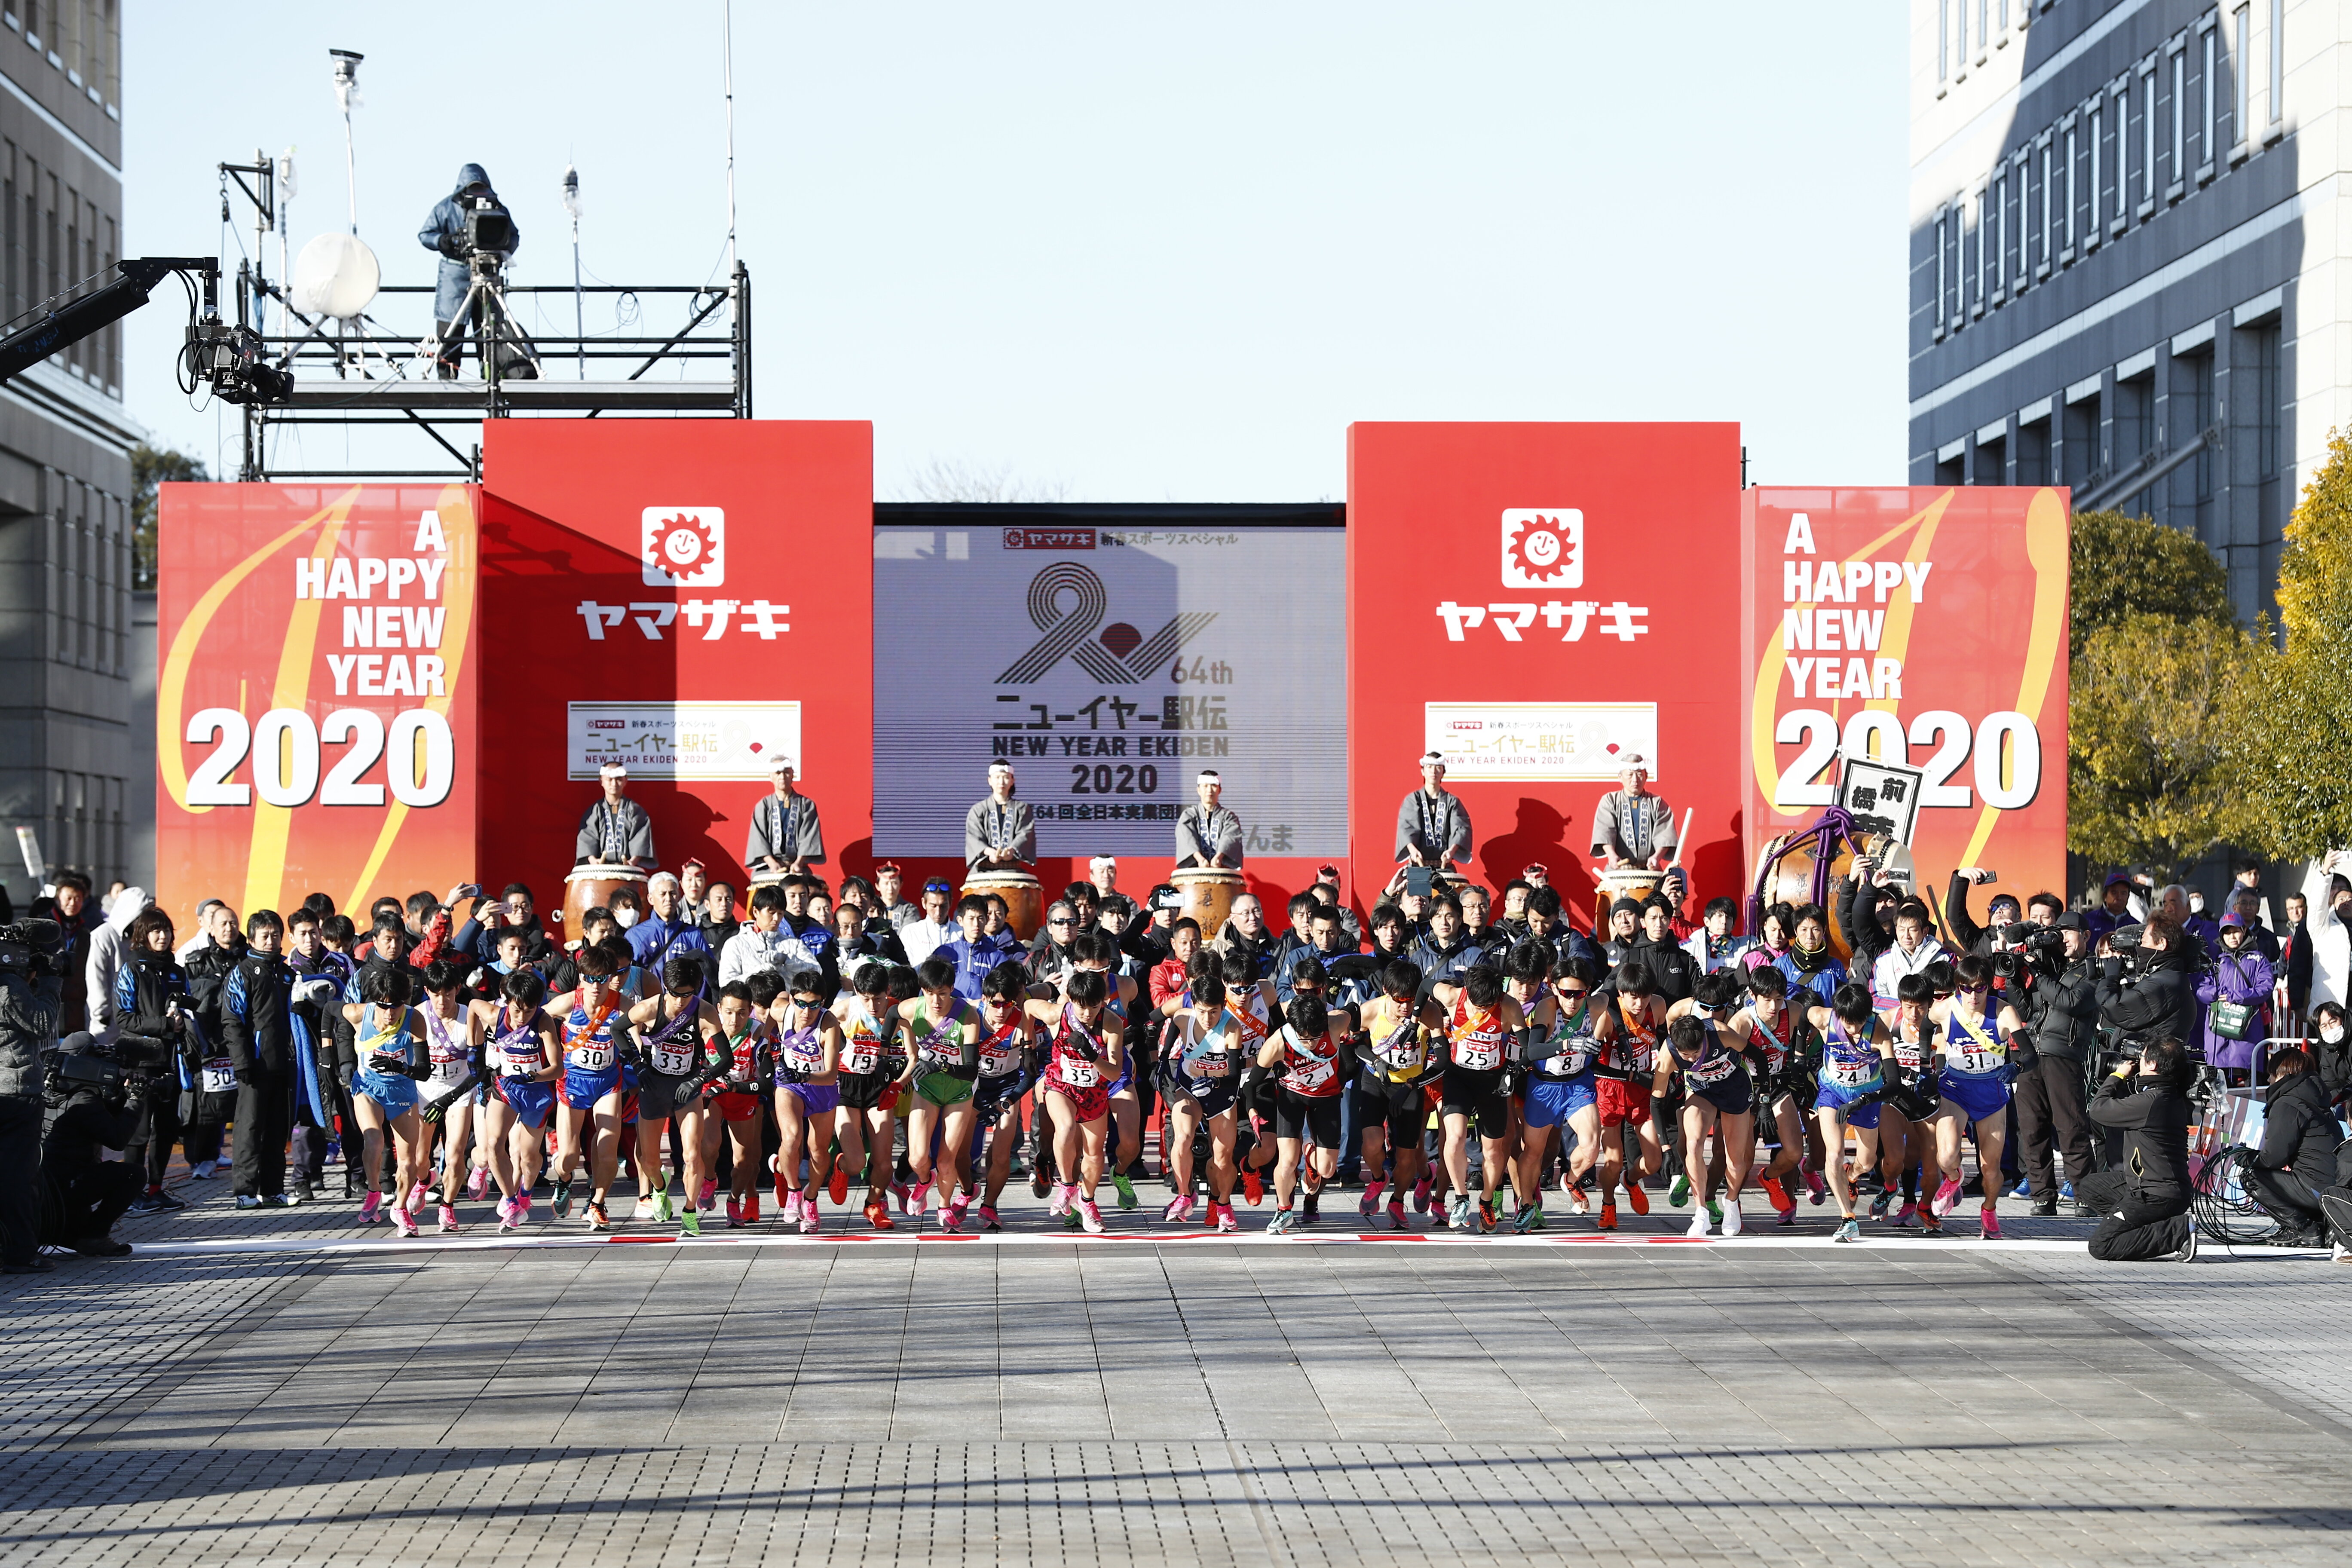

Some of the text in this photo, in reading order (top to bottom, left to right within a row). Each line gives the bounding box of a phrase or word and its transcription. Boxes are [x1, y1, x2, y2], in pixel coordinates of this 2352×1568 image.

[413, 510, 447, 551] A
[1784, 513, 1816, 554] A
[296, 558, 447, 600] HAPPY
[1784, 561, 1932, 603] HAPPY
[343, 606, 447, 648] NEW
[576, 599, 790, 640] ヤマザキ
[1436, 600, 1648, 642] ヤマザキ
[1783, 609, 1885, 651] NEW
[326, 654, 447, 696] YEAR
[1171, 656, 1233, 684] 64th
[1785, 657, 1903, 699] YEAR
[993, 695, 1228, 730] ニューイヤー駅伝
[585, 733, 718, 752] ニューイヤー駅伝
[993, 736, 1229, 756] NEW YEAR EKIDEN
[1444, 735, 1575, 753] ニューイヤー駅伝
[185, 707, 454, 808] 2020
[585, 755, 707, 763] NEW YEAR EKIDEN 2020
[1072, 765, 1158, 793] 2020
[1031, 804, 1182, 821] 64回全日本実業団
[1242, 824, 1293, 852] んま
[2230, 1004, 2246, 1014] AED
[670, 1033, 692, 1041] MO
[580, 1049, 611, 1064] 30-1
[659, 1053, 690, 1070] 33-1
[1465, 1051, 1497, 1066] 25-1
[1562, 1057, 1583, 1071] 8-1
[1964, 1054, 1996, 1069] 31-1
[1070, 1068, 1099, 1083] 35-1
[1304, 1071, 1329, 1084] 2-1
[1836, 1070, 1868, 1083] 24-1
